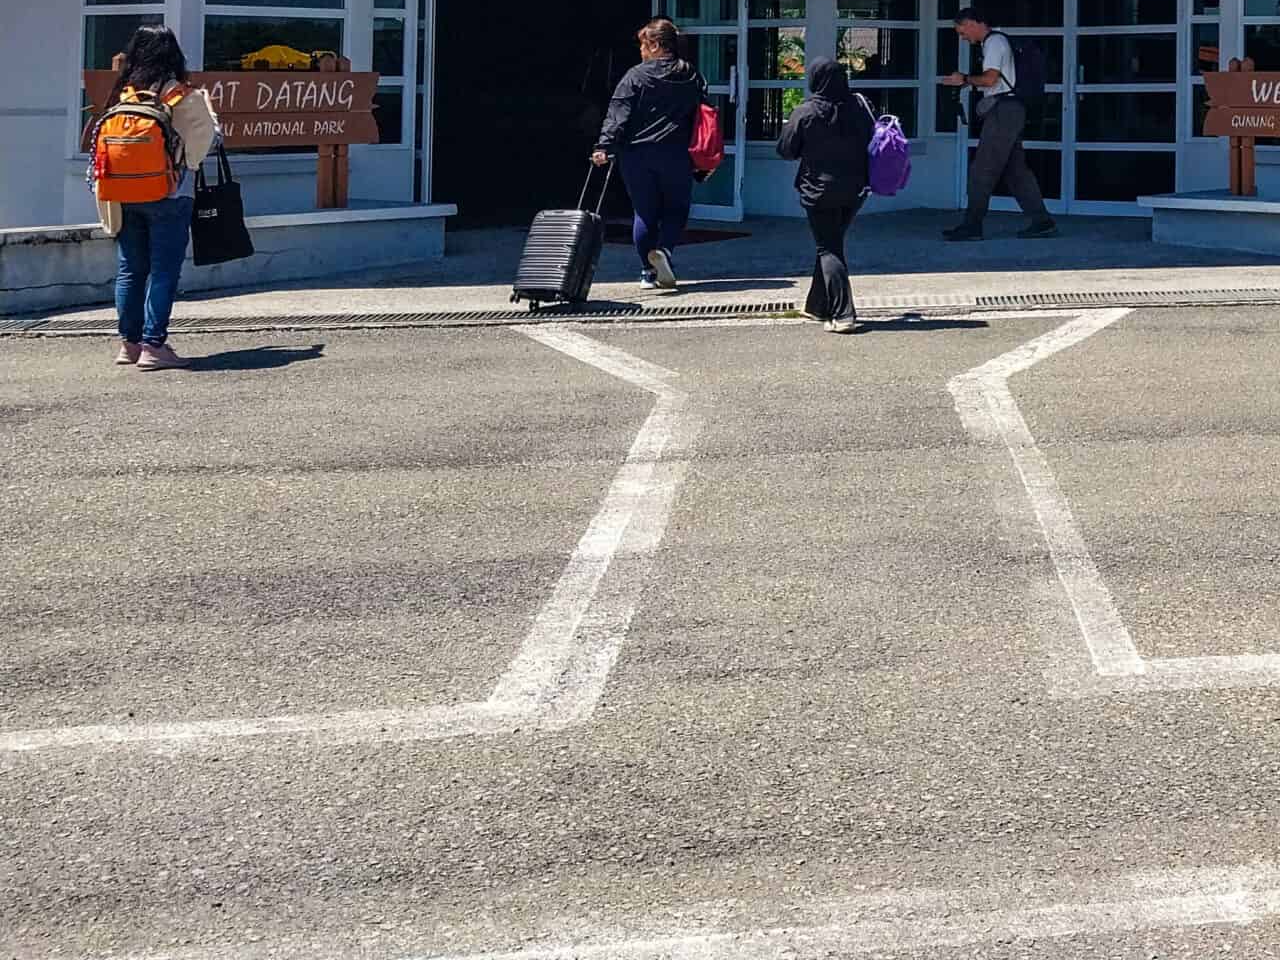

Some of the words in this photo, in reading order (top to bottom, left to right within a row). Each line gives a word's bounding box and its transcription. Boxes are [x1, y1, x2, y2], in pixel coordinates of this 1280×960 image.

[256, 79, 355, 110] DATANG
[242, 121, 306, 137] NATIONAL
[313, 119, 345, 135] PARK
[1231, 114, 1276, 129] GUNUNG
